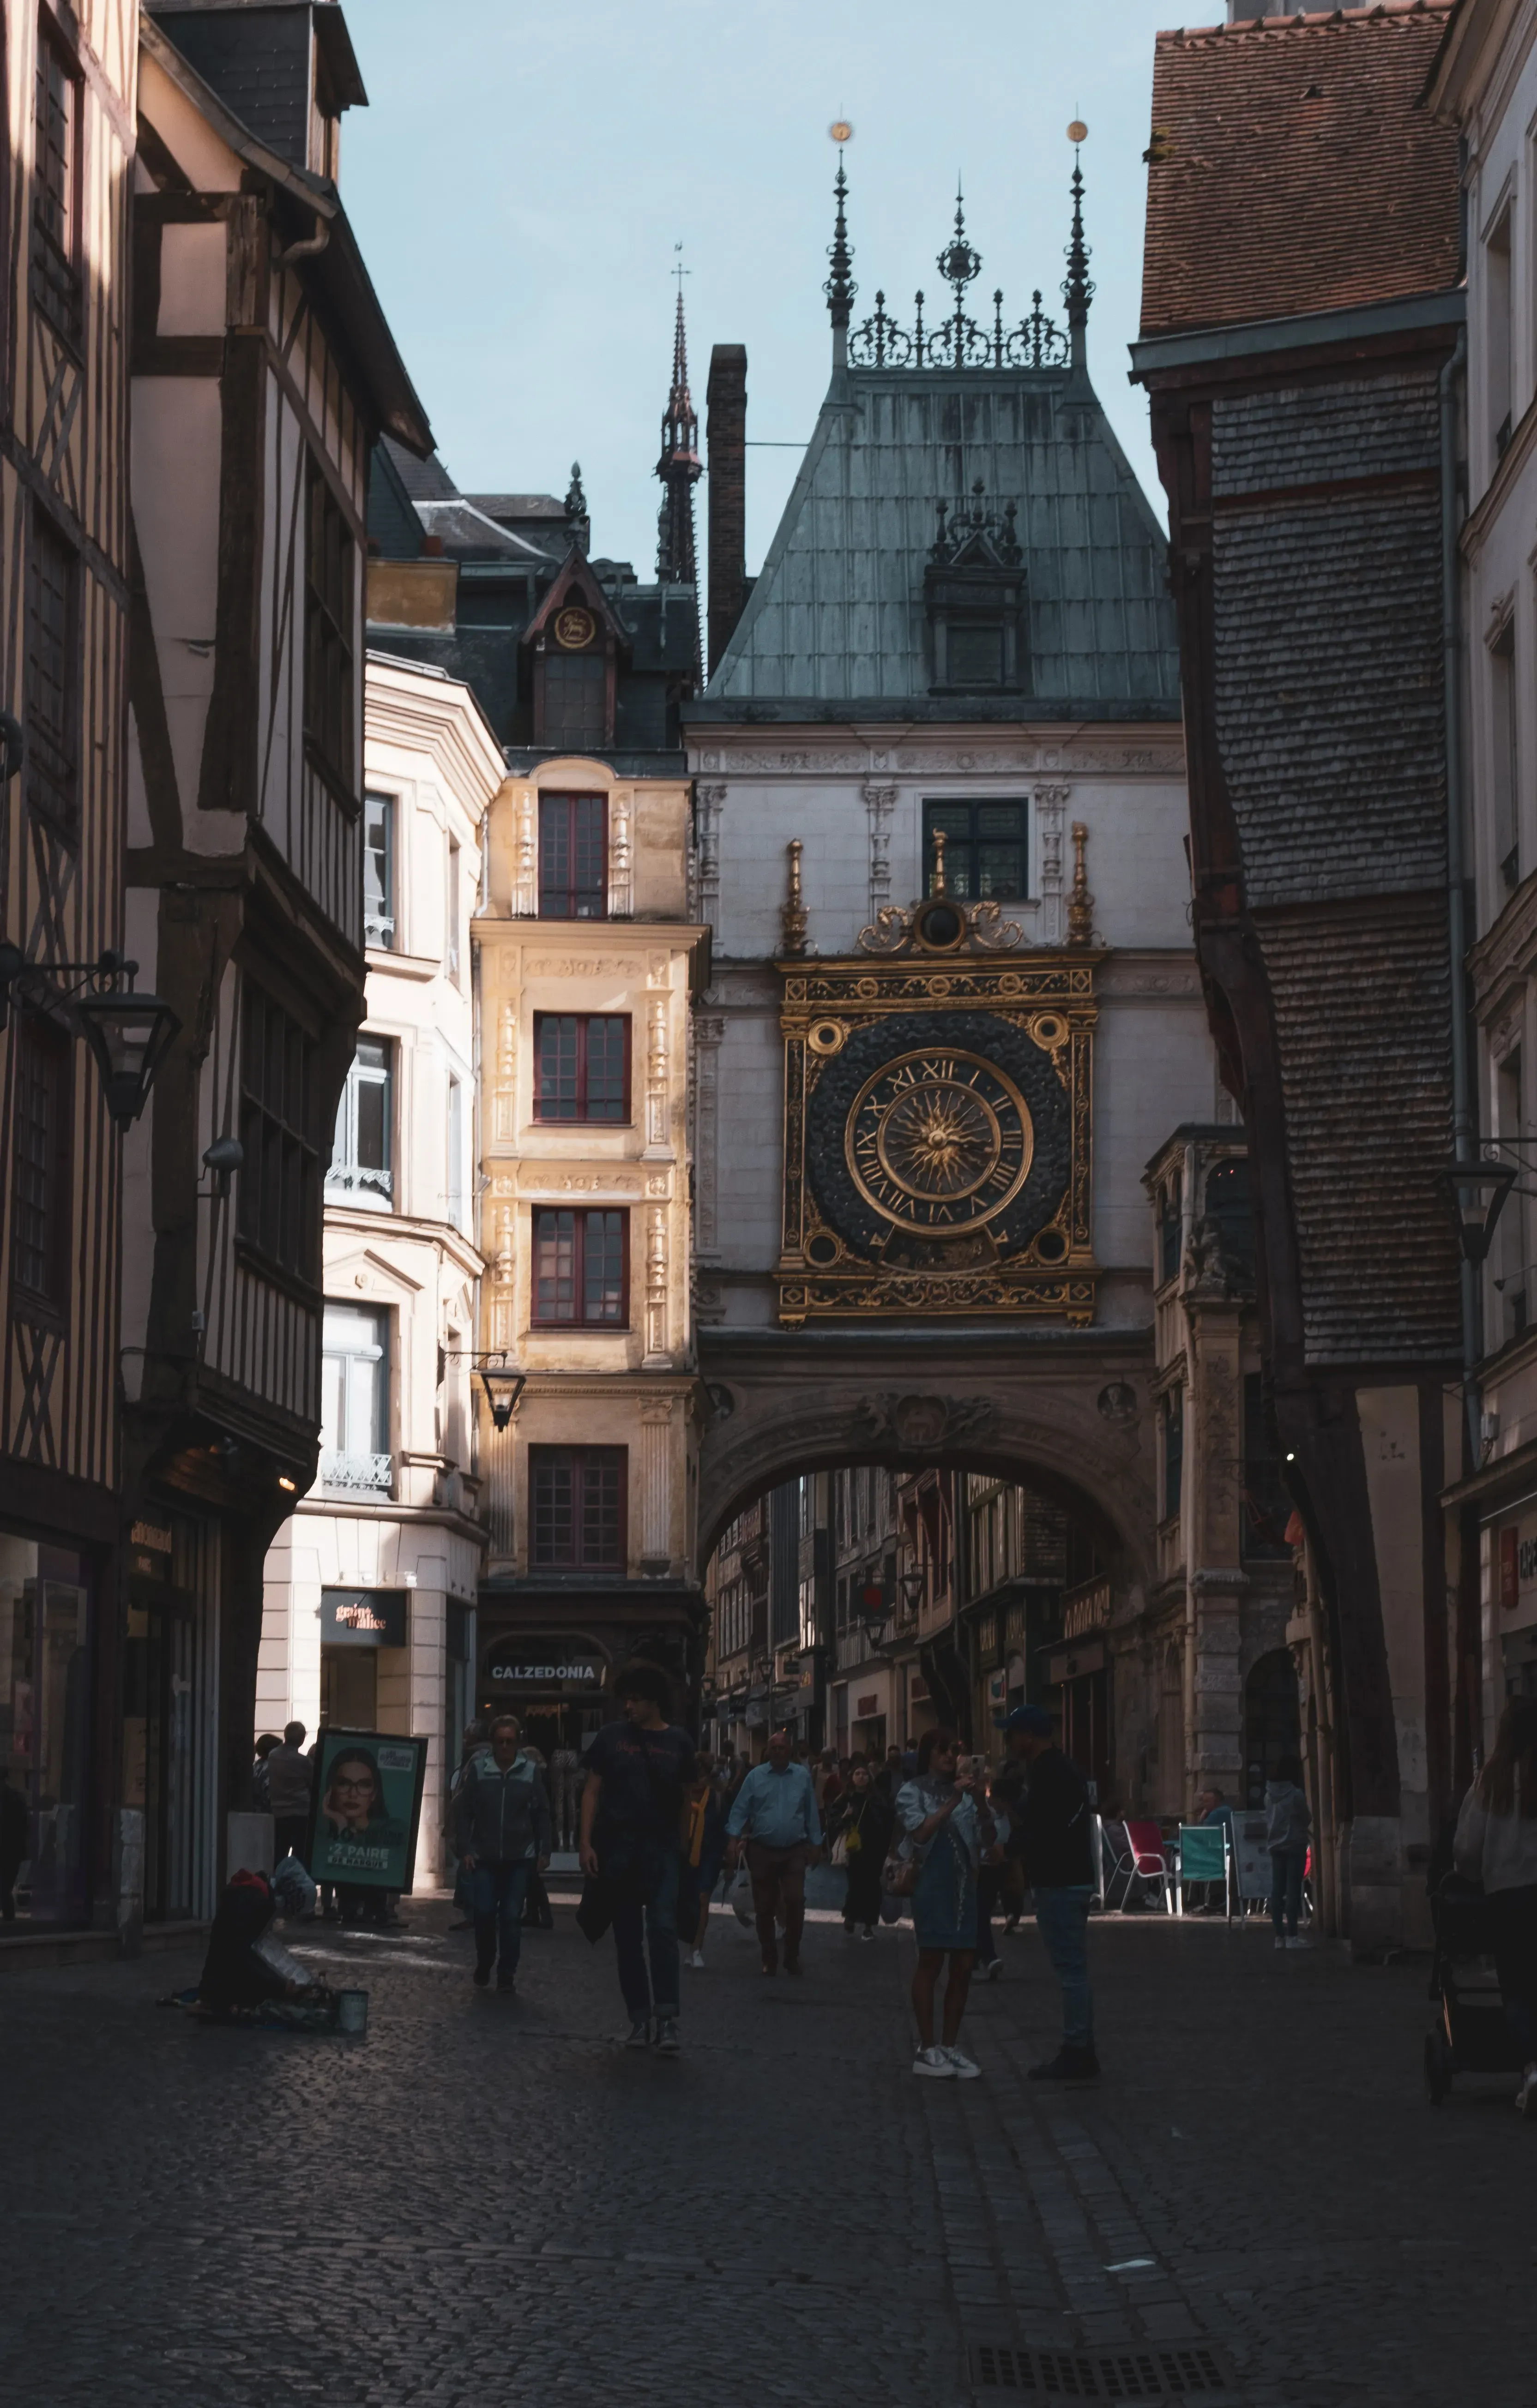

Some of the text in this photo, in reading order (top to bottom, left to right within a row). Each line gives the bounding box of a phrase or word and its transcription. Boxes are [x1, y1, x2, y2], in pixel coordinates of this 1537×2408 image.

[922, 1060, 954, 1080] XII
[970, 1070, 980, 1087] I
[886, 1066, 916, 1094] XI
[863, 1094, 889, 1118] X
[992, 1094, 1013, 1112] II
[856, 1129, 876, 1154] IX
[1003, 1130, 1022, 1149] III
[861, 1159, 888, 1199] VIII
[887, 1189, 915, 1219] VII
[928, 1203, 954, 1222] VI
[971, 1195, 988, 1215] V
[347, 1614, 386, 1629] malice
[492, 1665, 595, 1679] CALZEDONIA
[348, 1845, 390, 1860] PAIRE
